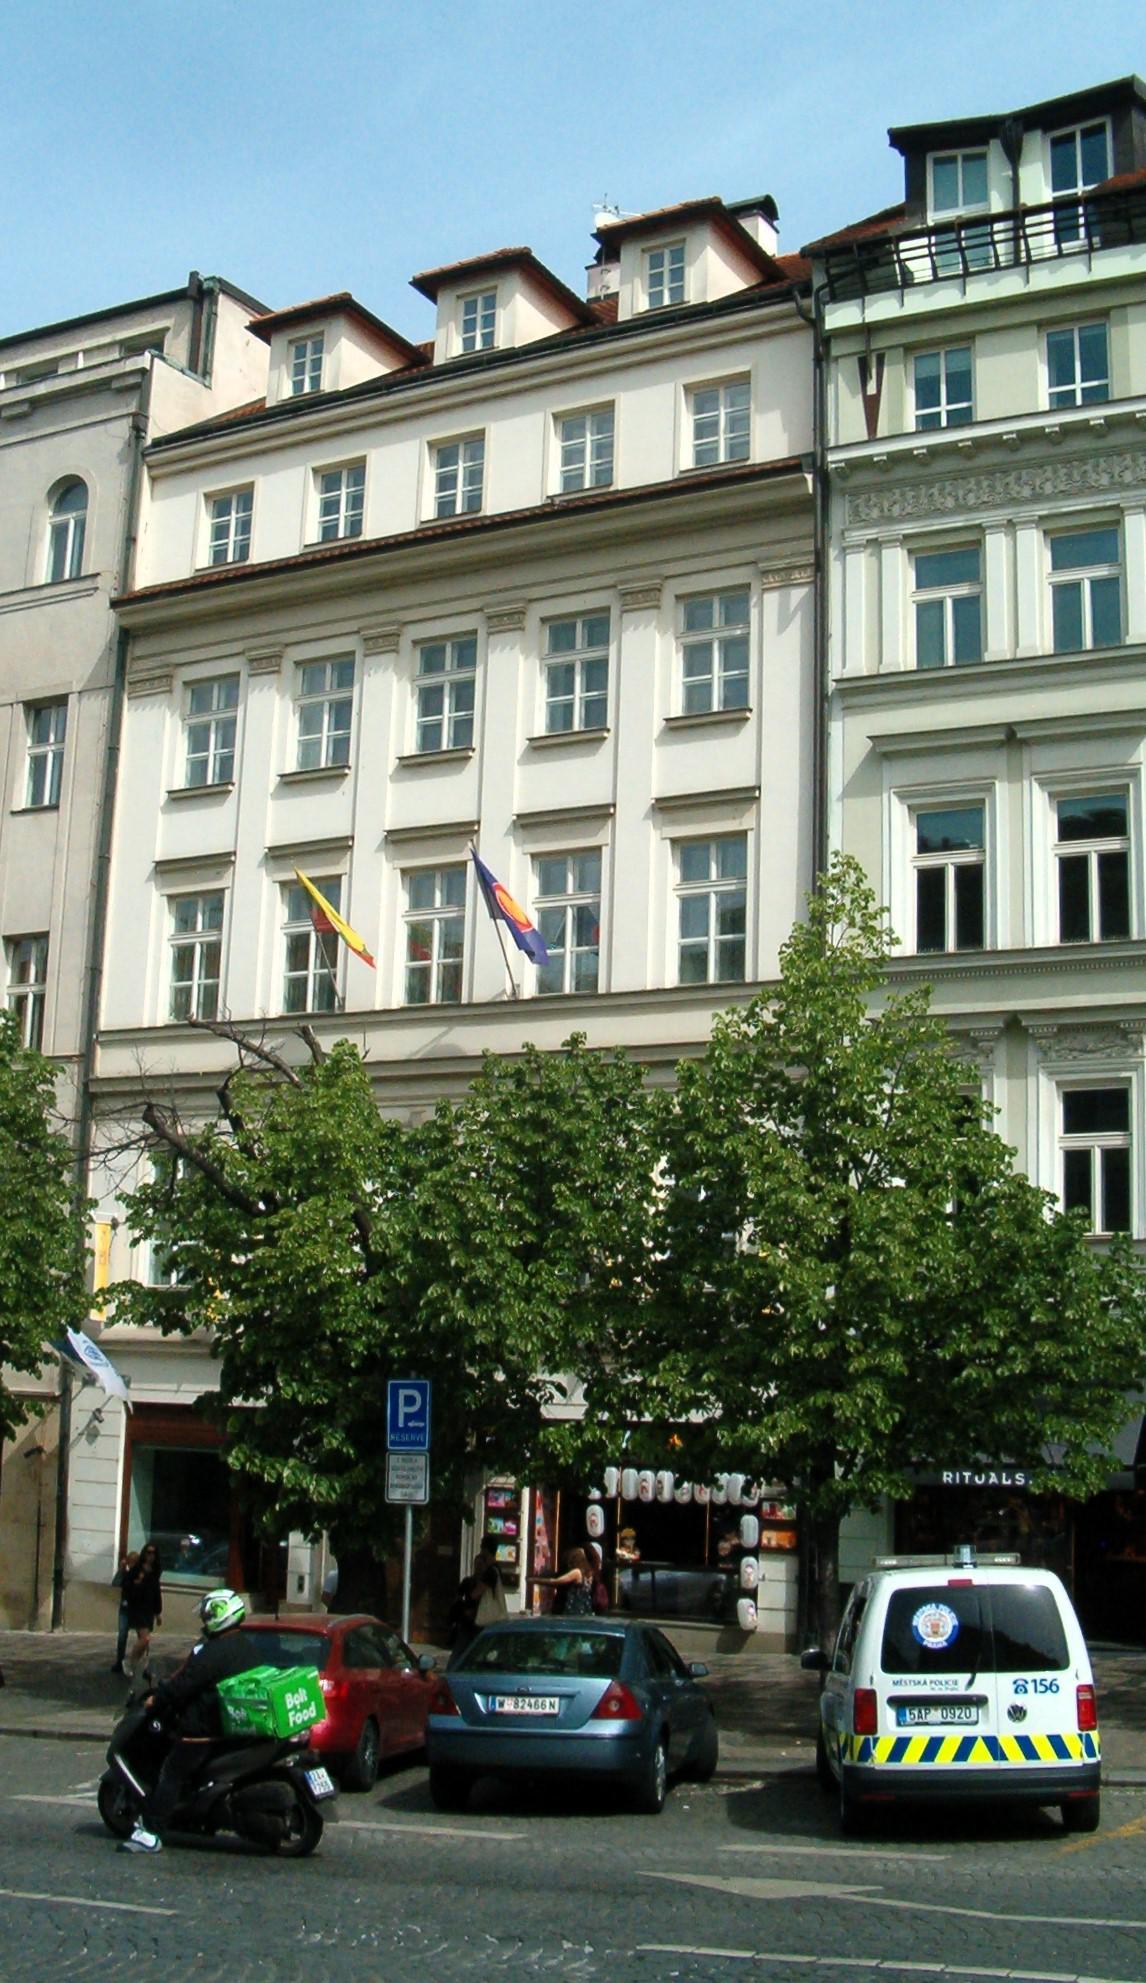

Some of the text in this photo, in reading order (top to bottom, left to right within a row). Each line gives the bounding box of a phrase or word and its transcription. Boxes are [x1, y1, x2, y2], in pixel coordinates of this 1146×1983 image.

[398, 1388, 422, 1427] P
[1031, 1678, 1060, 1694] 156
[284, 1687, 308, 1710] Bolt
[288, 1701, 317, 1727] Food
[941, 1706, 972, 1720] 0920
